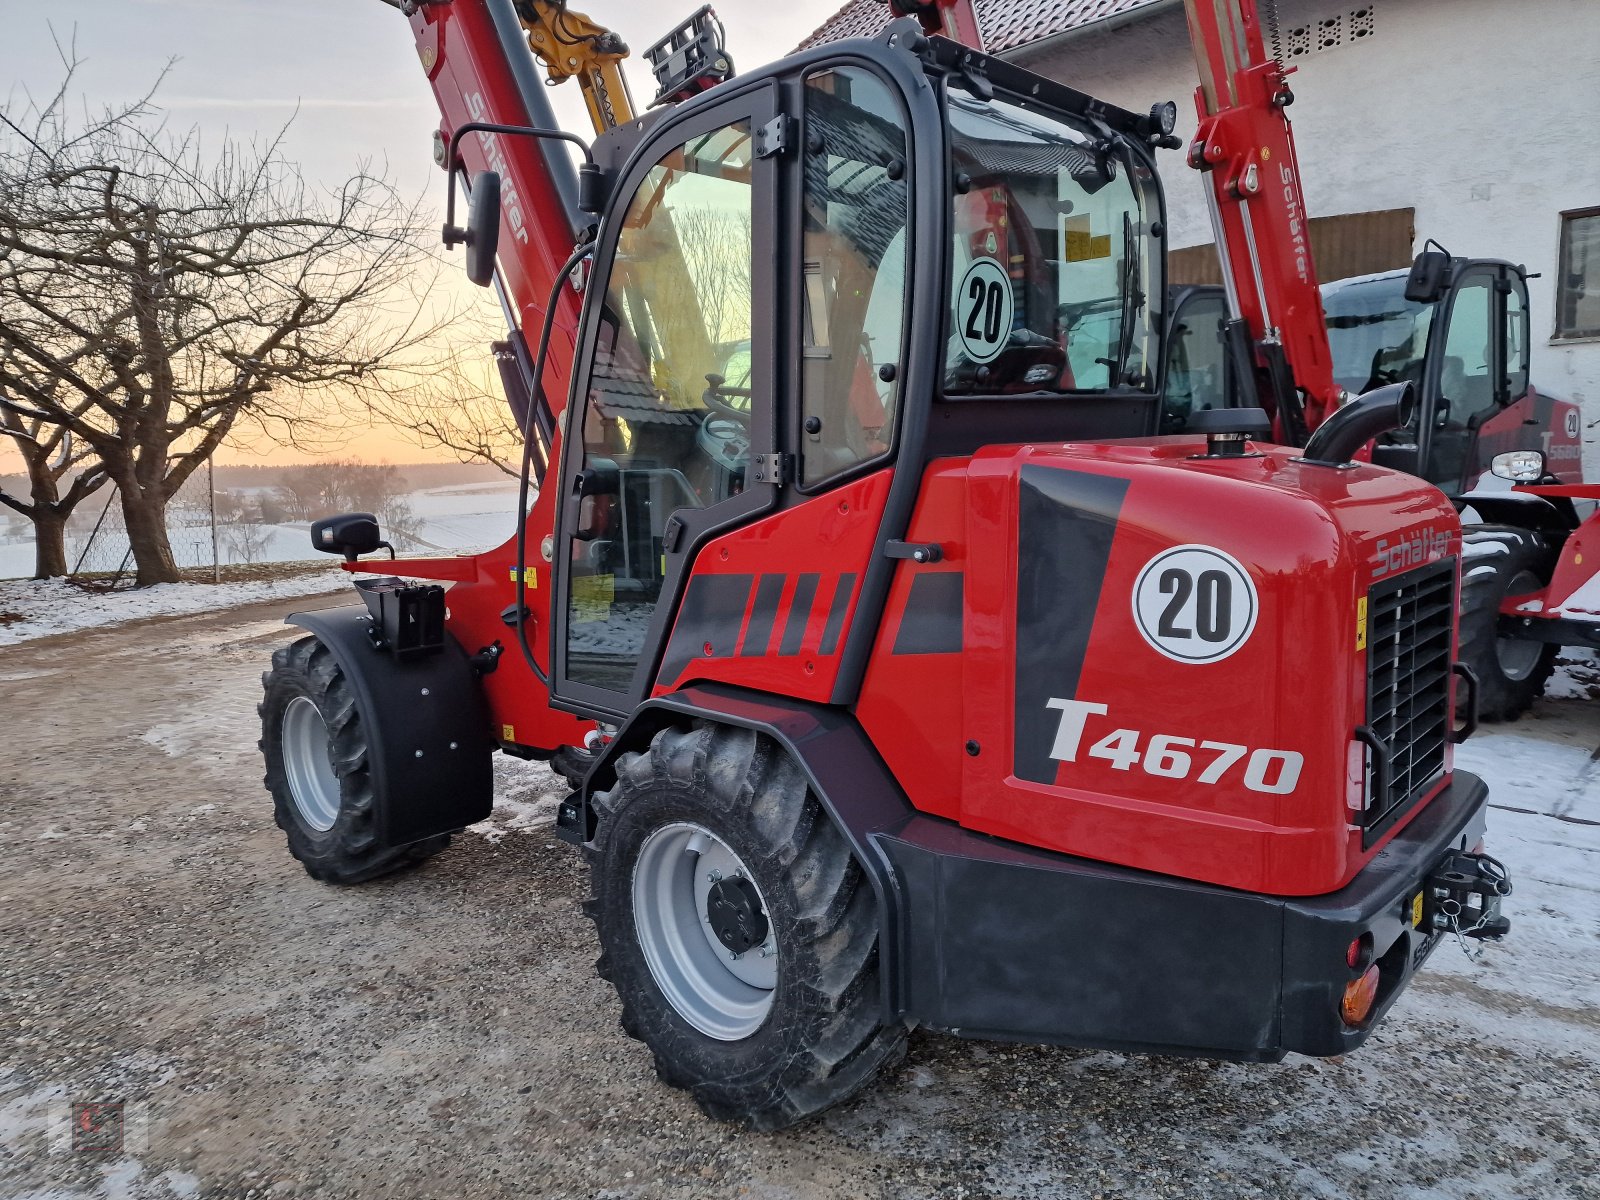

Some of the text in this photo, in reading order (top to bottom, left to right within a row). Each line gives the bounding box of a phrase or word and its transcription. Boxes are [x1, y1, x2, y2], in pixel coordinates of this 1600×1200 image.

[1279, 162, 1308, 284] Schäffer
[965, 276, 1004, 343] 20
[1568, 415, 1577, 432] 20
[1371, 526, 1453, 577] Schäffer
[1157, 567, 1233, 643] 20
[1045, 697, 1305, 794] T4670
